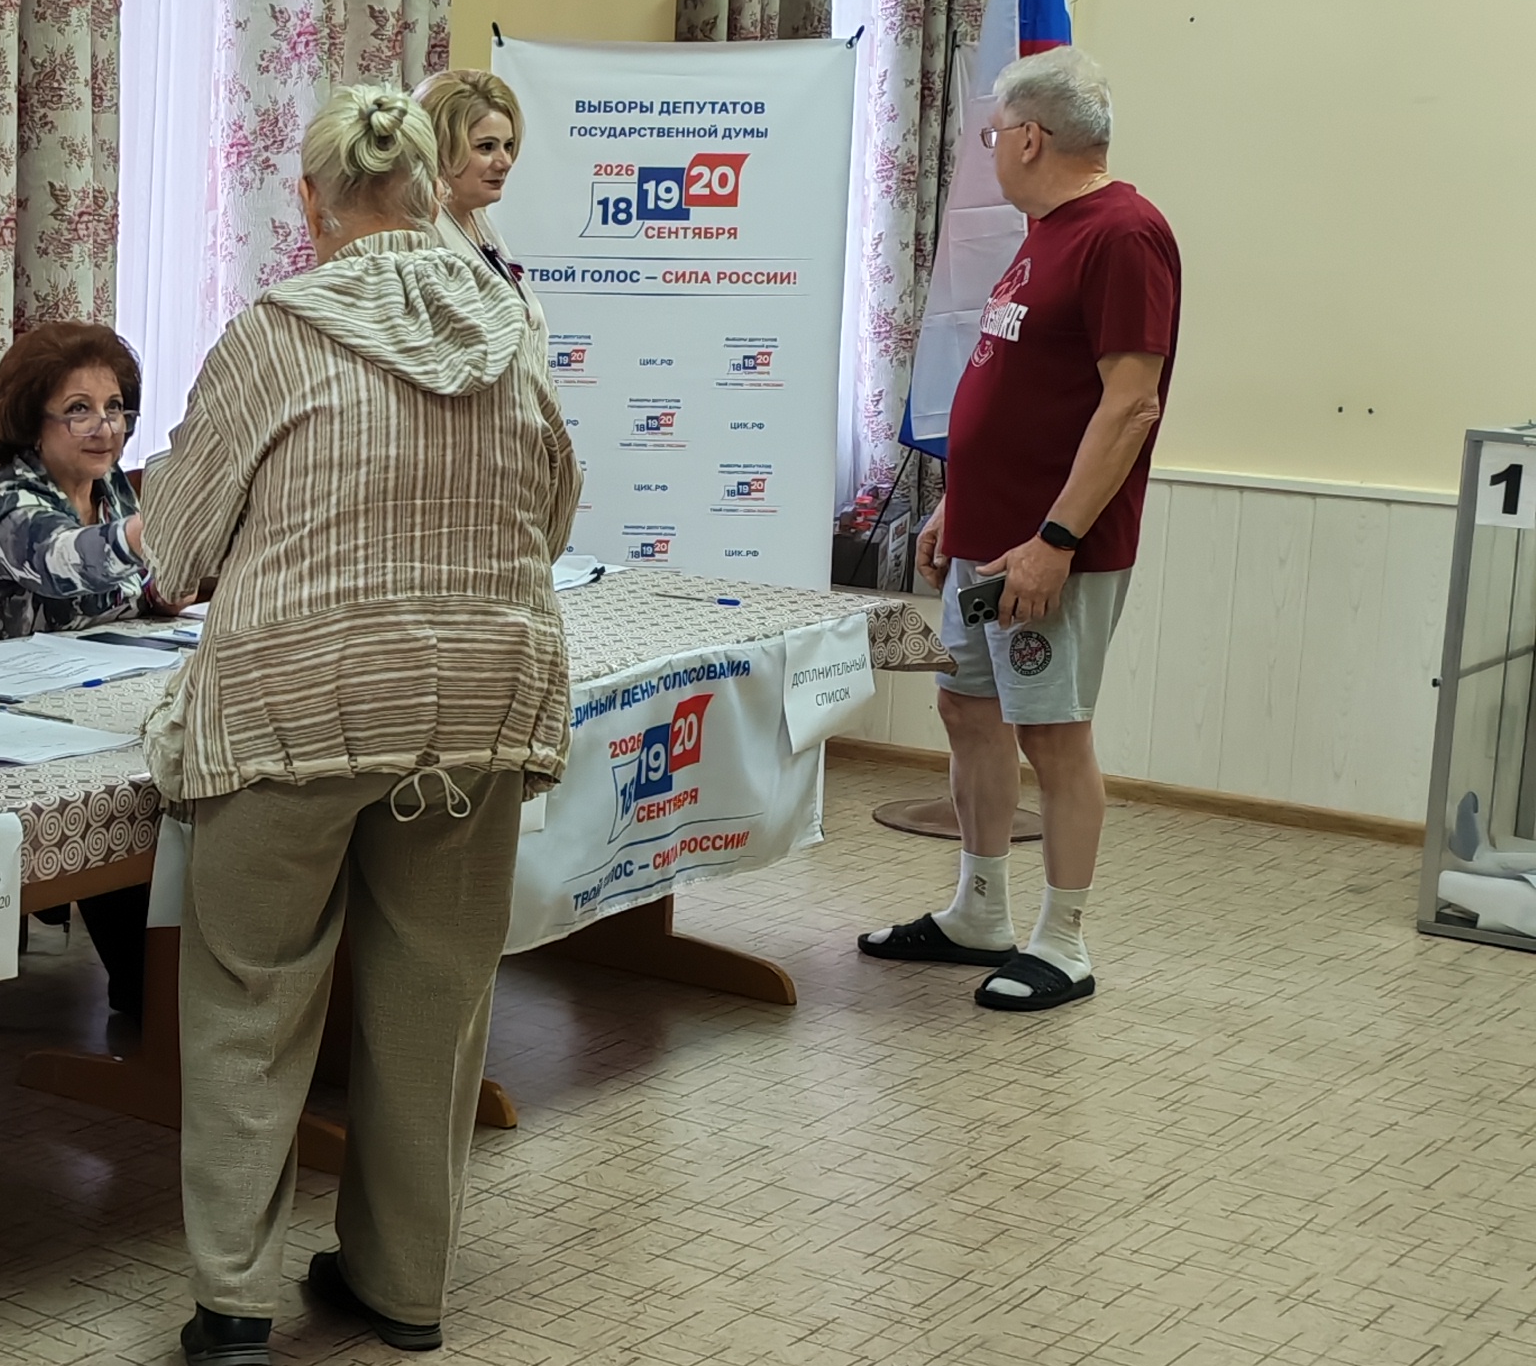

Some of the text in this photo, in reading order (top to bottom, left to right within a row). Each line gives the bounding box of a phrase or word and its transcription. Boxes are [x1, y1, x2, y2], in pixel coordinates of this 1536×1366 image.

[575, 100, 766, 117] ВЫБОРЫ ДЕПУТАТОВ
[569, 124, 769, 141] ГОСУДАРСТВЕННОЙ ДУМЫ
[592, 163, 635, 177] 2026
[596, 165, 736, 226] 18 19 20
[644, 226, 738, 241] СЕНТЯБРЯ
[528, 265, 577, 283] ТВОЙ
[580, 269, 641, 284] ГОЛОС
[661, 270, 711, 285] СИЛА
[716, 271, 798, 286] РОССИИ!
[558, 356, 569, 365] 19
[570, 352, 584, 361] 20
[639, 358, 674, 367] ЦИК.РФ
[732, 355, 770, 371] 18 19 20
[635, 416, 673, 432] 18 19 20
[730, 421, 765, 431] ЦИК.РФ
[633, 484, 668, 493] ЦИК.РФ
[726, 481, 764, 497] 18 19 20
[1489, 463, 1523, 515] 1
[630, 542, 668, 559] 18 19 20
[724, 549, 760, 558] ЦИК.РФ
[620, 680, 656, 711] ДЕНЬ
[815, 686, 851, 707] СПИСОК
[608, 732, 643, 759] 2026
[640, 742, 667, 785] 19
[671, 712, 699, 757] 20
[679, 830, 750, 857] РОССИИ!
[0, 895, 11, 909] 20
